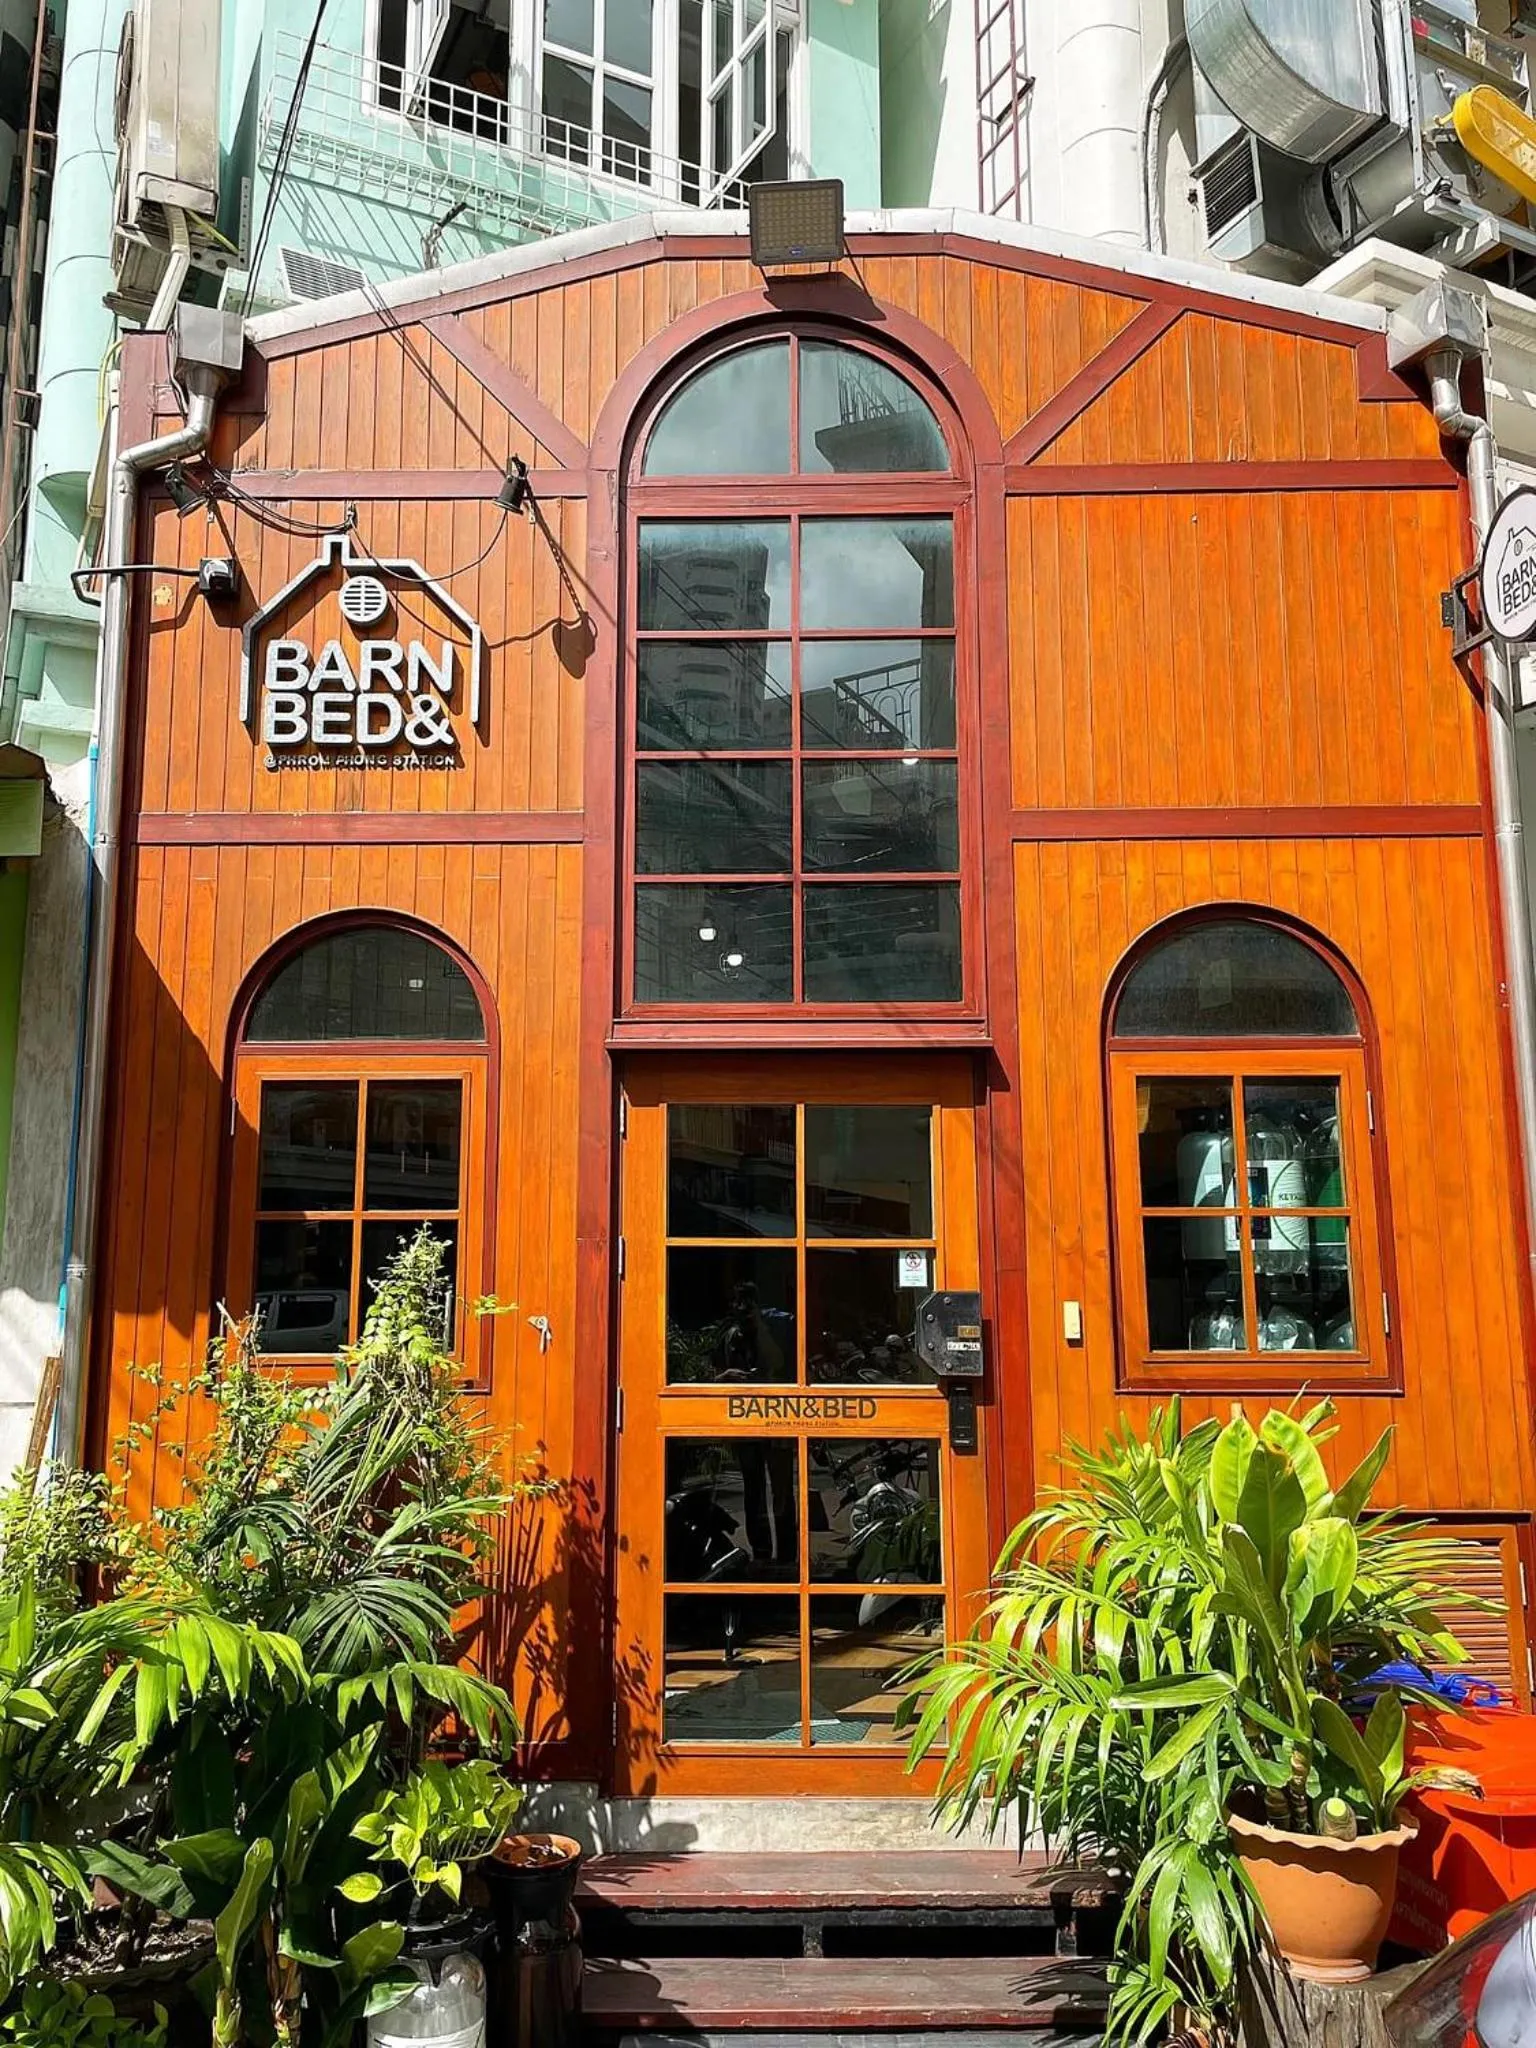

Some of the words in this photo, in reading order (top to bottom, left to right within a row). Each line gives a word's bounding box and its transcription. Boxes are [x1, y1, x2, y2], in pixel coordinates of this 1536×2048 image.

[264, 639, 453, 692] BARN
[263, 692, 453, 746] BED&
[392, 754, 455, 767] STATION
[728, 1397, 877, 1419] BARN&BED
